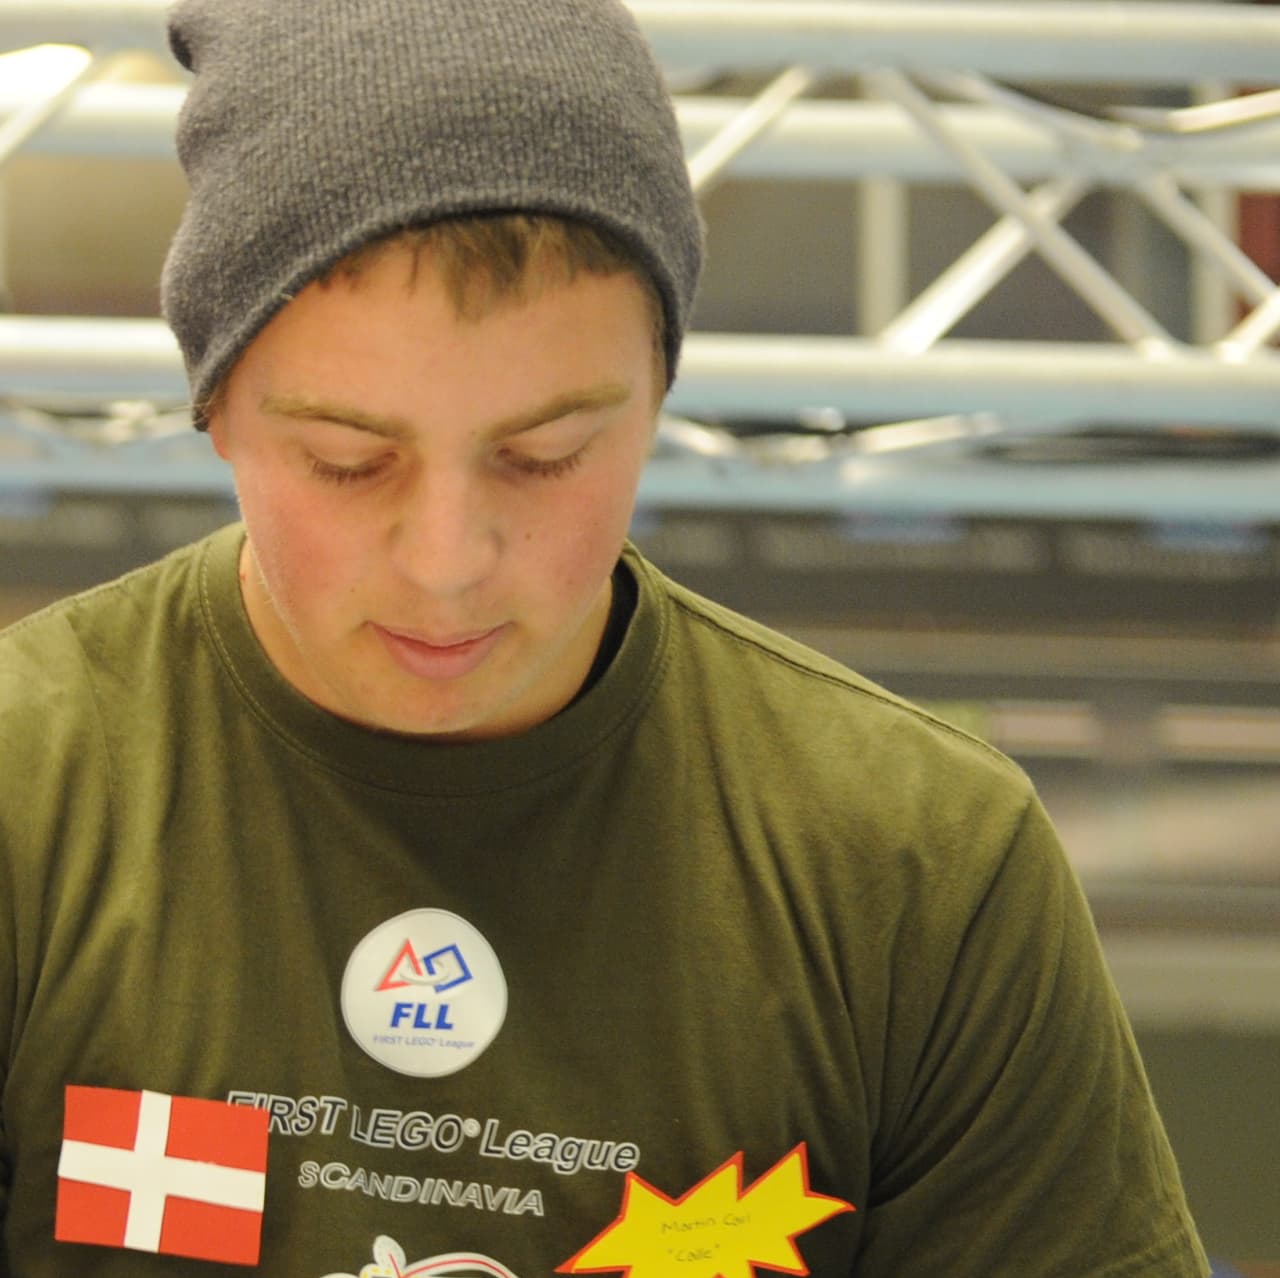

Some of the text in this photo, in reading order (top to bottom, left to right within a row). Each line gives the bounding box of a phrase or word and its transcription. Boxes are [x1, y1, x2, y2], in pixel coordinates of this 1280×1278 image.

[390, 1002, 454, 1030] FLL
[227, 1091, 348, 1137] RST
[479, 1119, 641, 1176] League
[297, 1160, 545, 1216] SCANDINAVIA
